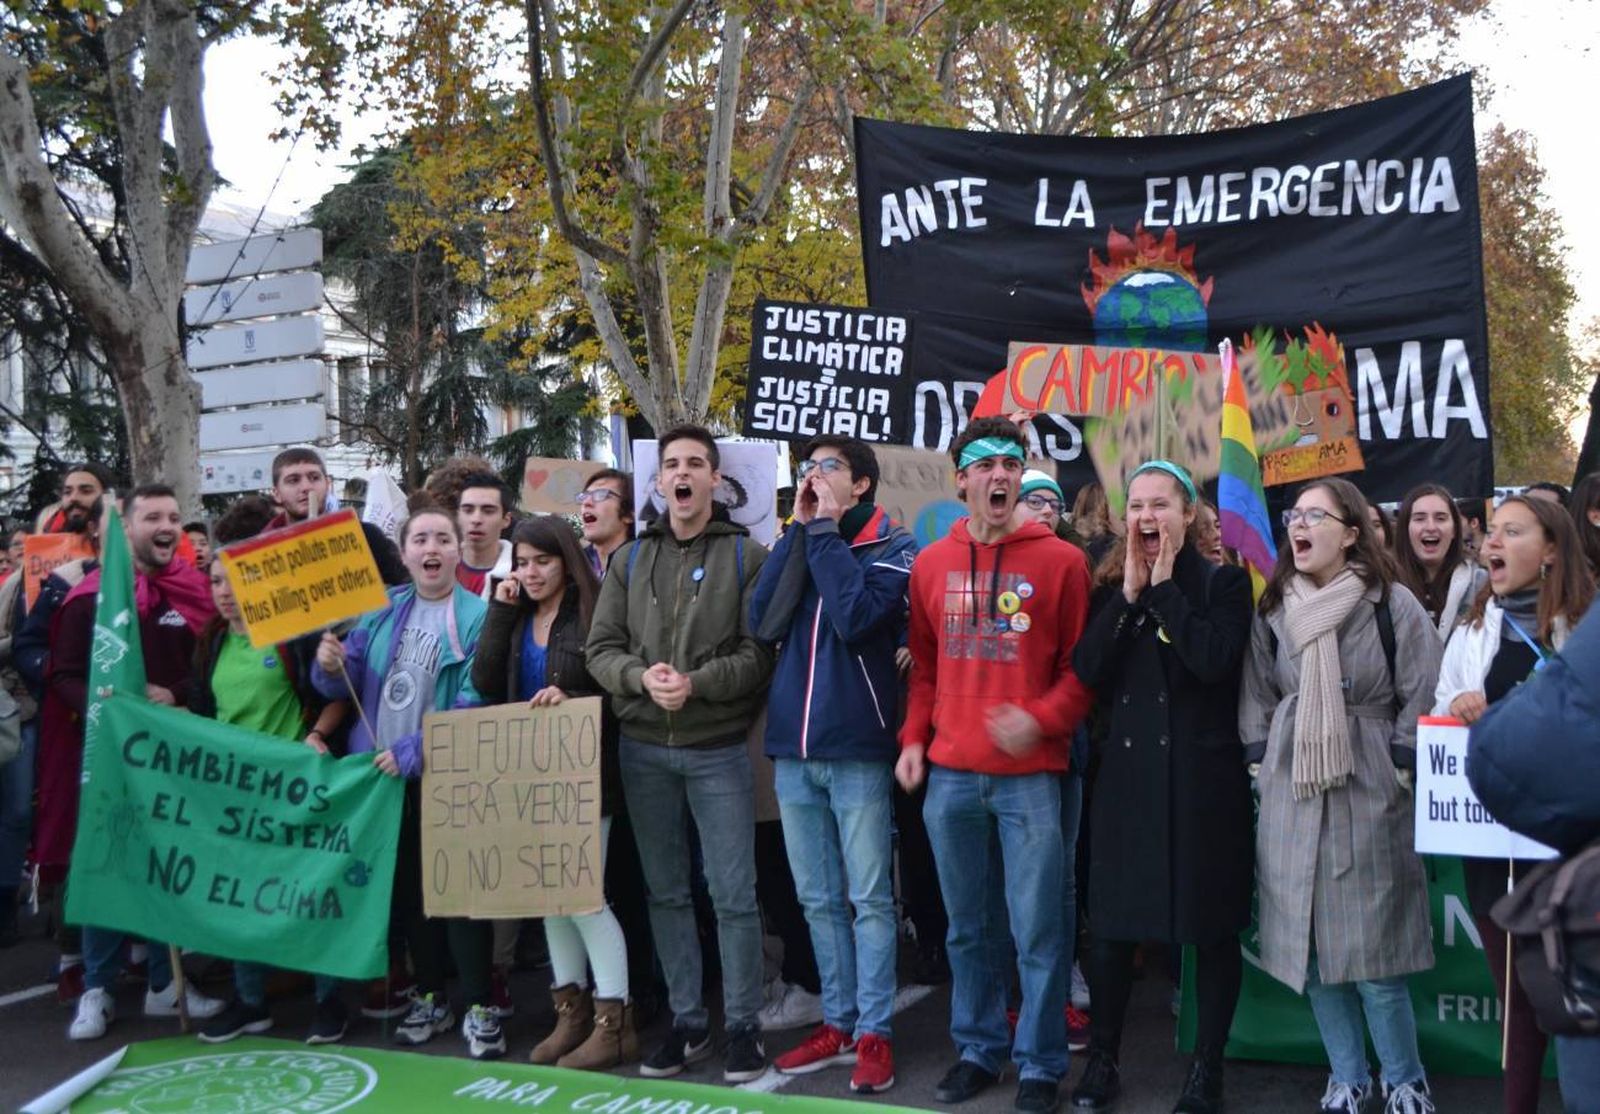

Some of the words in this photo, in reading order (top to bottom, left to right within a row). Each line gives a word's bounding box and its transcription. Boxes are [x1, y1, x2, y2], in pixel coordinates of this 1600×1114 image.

[880, 177, 988, 247] ANTE
[1034, 178, 1095, 228] LA
[1143, 156, 1460, 228] EMERGENCIA
[764, 306, 907, 343] JUSTICIA
[757, 376, 890, 416] JUSTICIA
[751, 402, 891, 441] SOCIAL!
[236, 560, 262, 586] The
[262, 551, 287, 579] rich
[286, 540, 329, 577] pollute
[328, 531, 363, 556] more,
[243, 598, 272, 625] thus
[270, 586, 311, 615] killing
[309, 577, 336, 602] over
[337, 566, 377, 592] others.
[431, 723, 470, 774] EL
[477, 714, 597, 774] FUTURO
[1428, 744, 1457, 775] We
[151, 793, 192, 826] EL
[432, 777, 500, 828] SERÁ
[513, 781, 594, 827] VERDE
[1429, 790, 1458, 822] but
[147, 846, 196, 896] NO
[207, 874, 246, 908] EL
[433, 848, 449, 897] O
[468, 845, 502, 891] NO
[517, 835, 596, 888] SERÁ
[1437, 994, 1503, 1022] FRI
[453, 1076, 558, 1106] PARA
[571, 1092, 765, 1114] CAMBI
